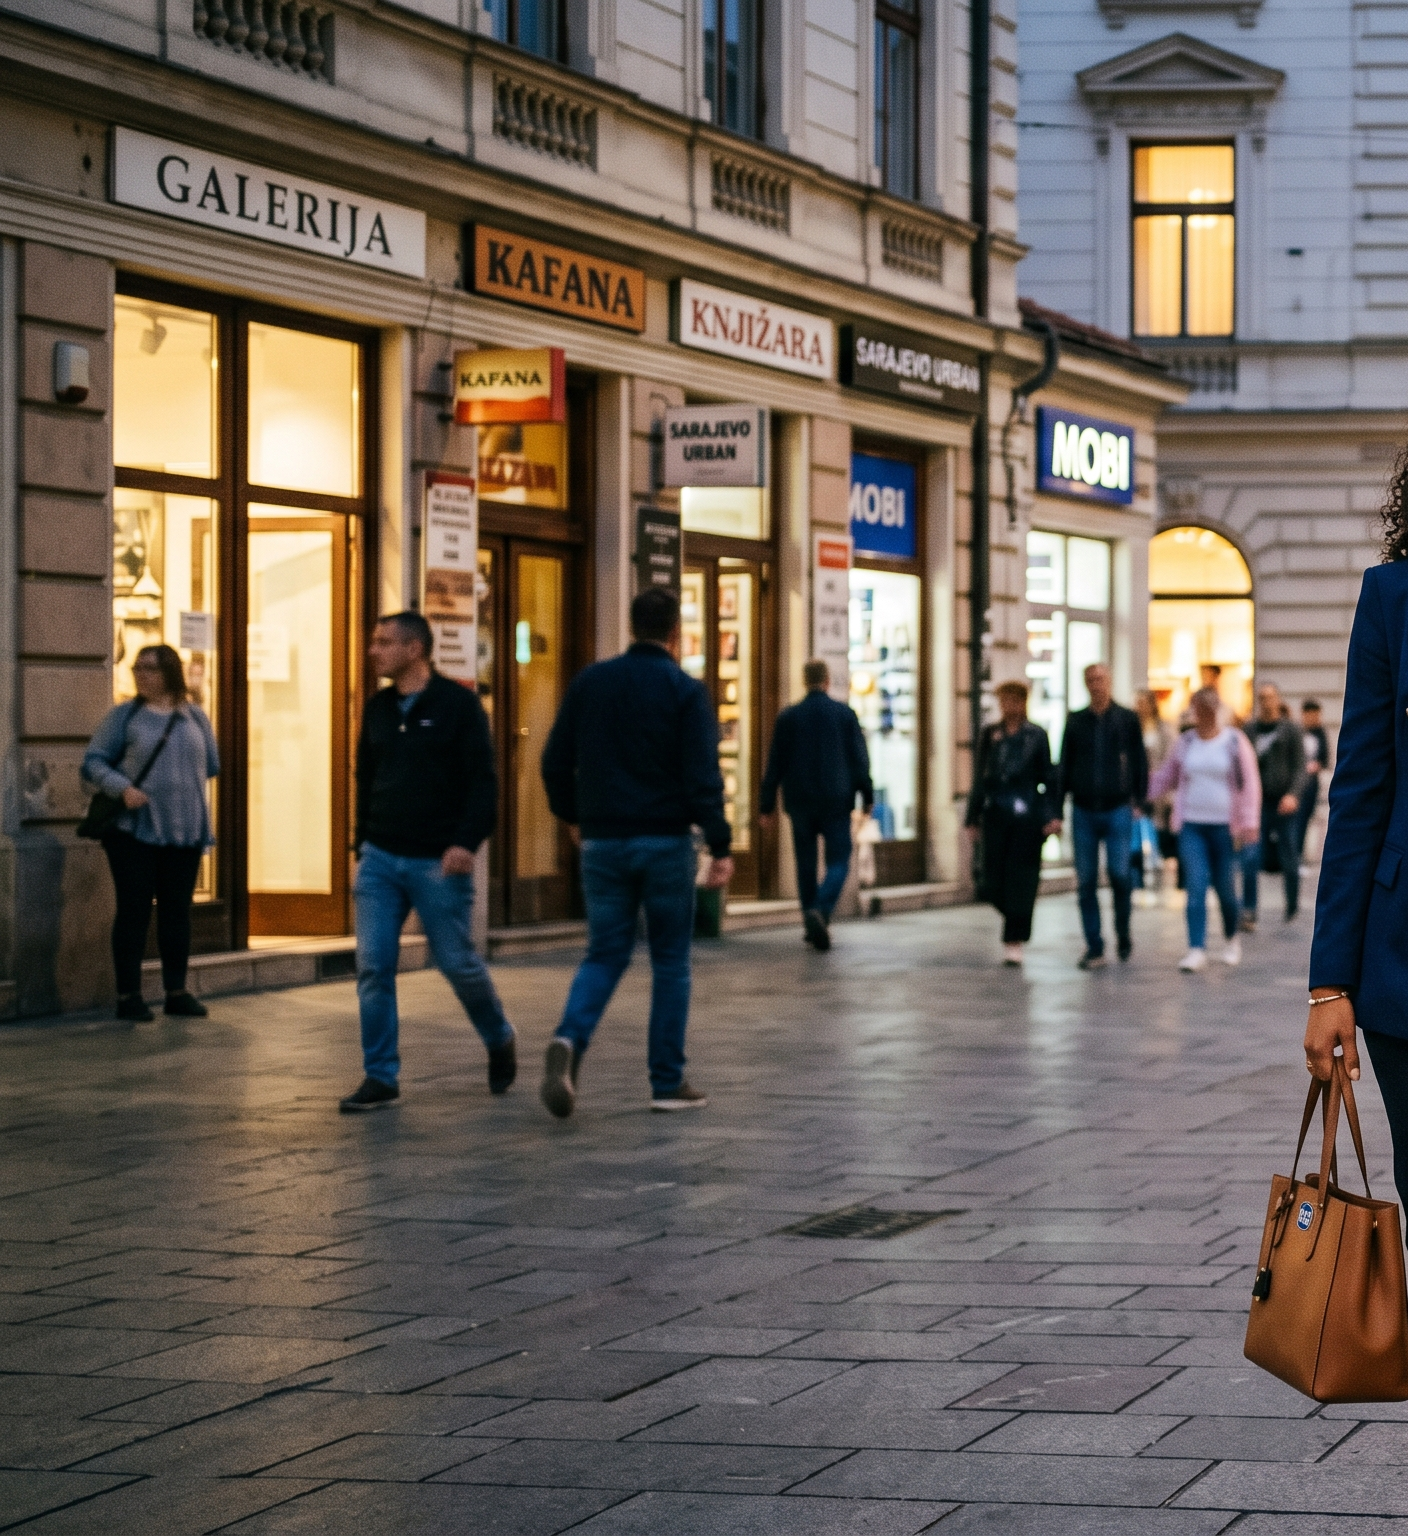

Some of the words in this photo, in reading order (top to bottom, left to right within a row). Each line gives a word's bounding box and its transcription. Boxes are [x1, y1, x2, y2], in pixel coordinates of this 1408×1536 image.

[156, 155, 393, 258] GALERIJA
[487, 239, 635, 320] KAFANA
[691, 298, 825, 366] KNJIŽARA
[459, 370, 543, 388] KAFANA
[856, 336, 932, 382] SARAJEVO
[932, 357, 981, 394] URBAN
[669, 420, 751, 440] SARAJEVO
[682, 443, 737, 462] URBAN
[1051, 420, 1130, 491] MOBI
